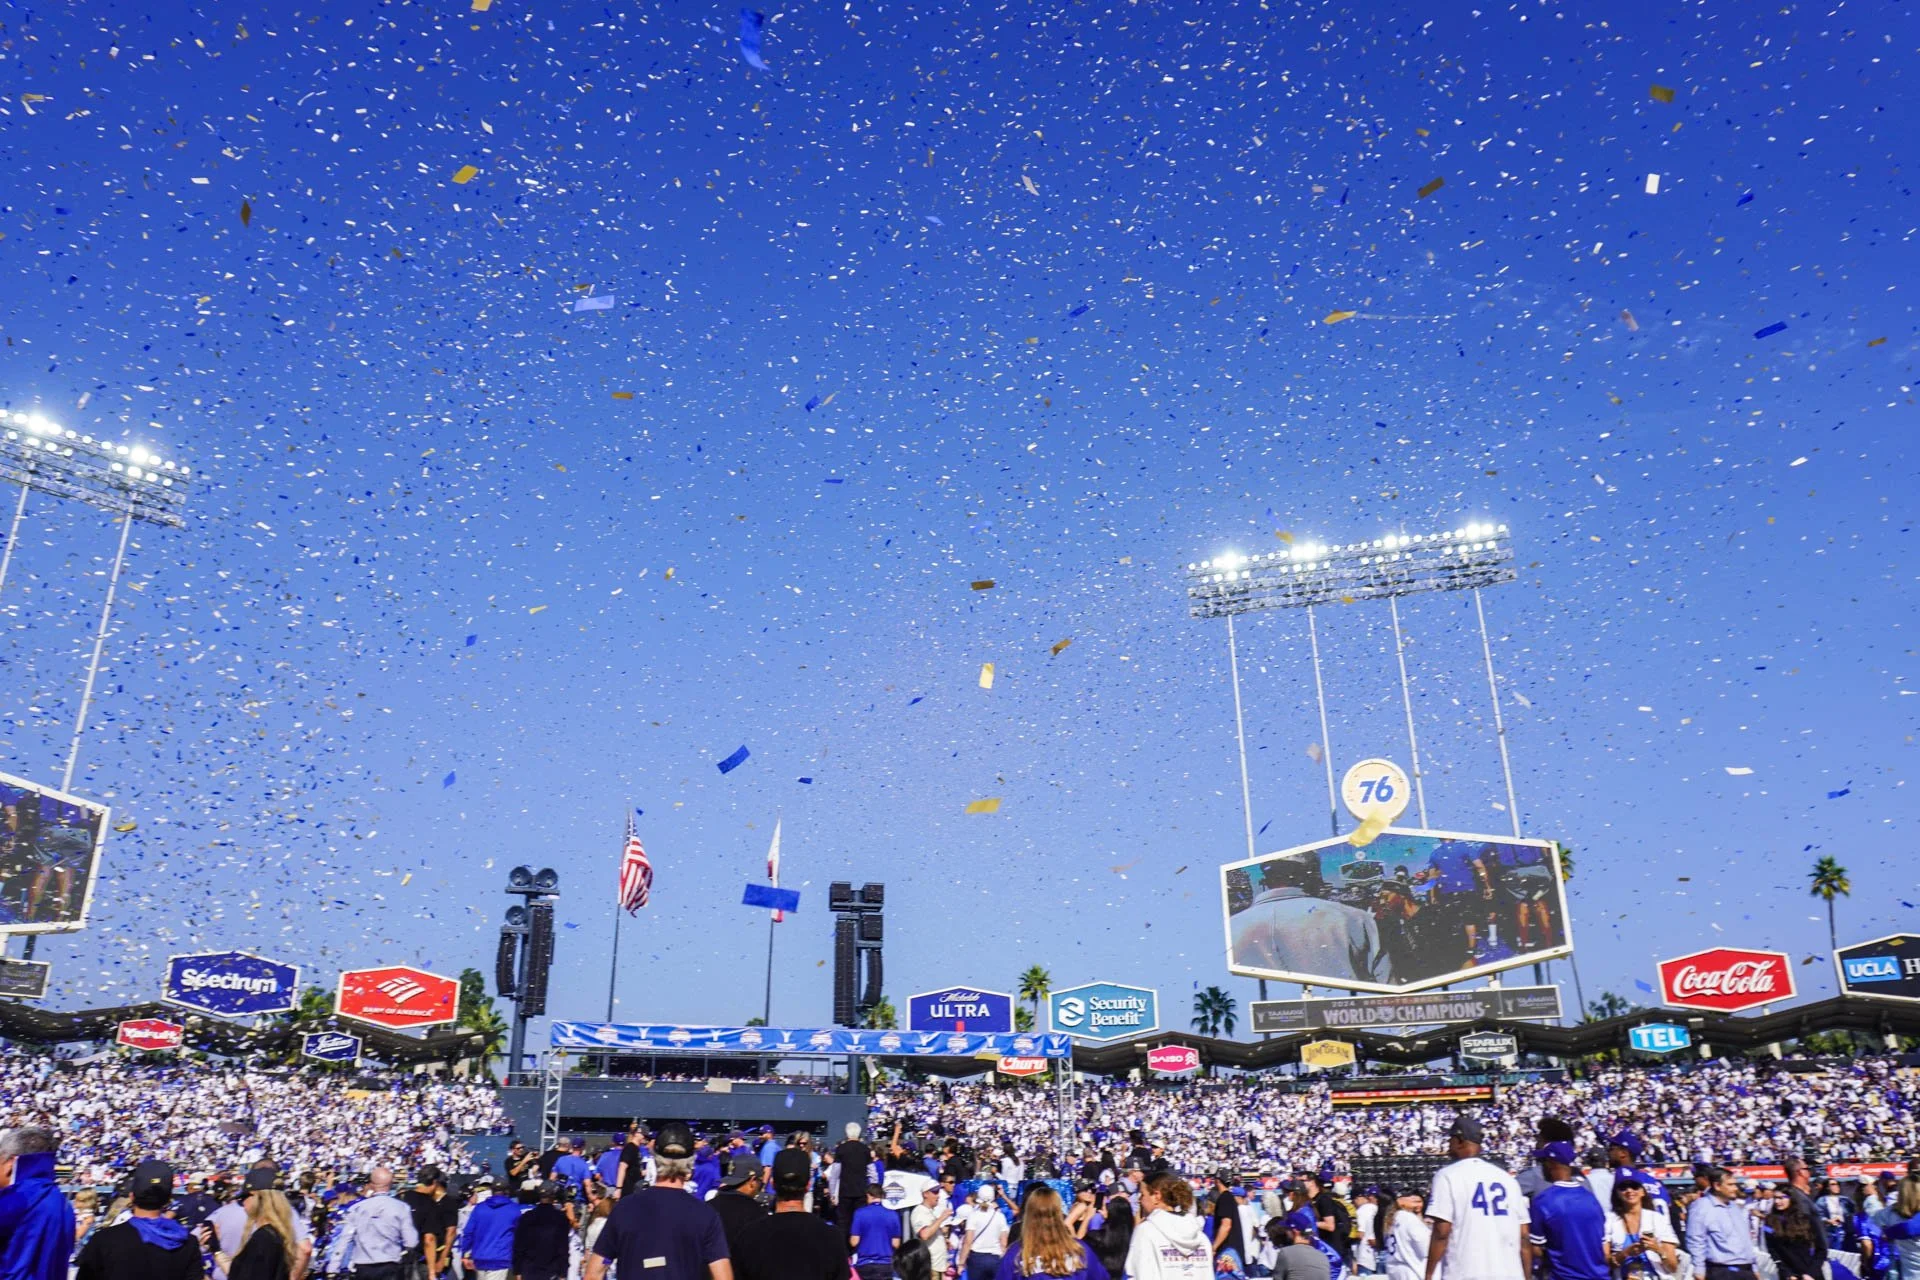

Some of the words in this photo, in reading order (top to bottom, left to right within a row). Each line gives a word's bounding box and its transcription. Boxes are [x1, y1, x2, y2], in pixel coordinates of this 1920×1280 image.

[1359, 775, 1393, 803] 76
[1848, 962, 1896, 977] UCLA
[180, 968, 278, 994] Spectrum
[930, 1003, 991, 1018] ULTRA
[1089, 996, 1147, 1011] Security
[1090, 1011, 1140, 1026] Benefit
[1322, 1006, 1377, 1025] WORLD
[1396, 1001, 1486, 1023] CHAMPIONS
[1463, 1038, 1513, 1048] STARLUX
[1635, 1028, 1684, 1048] TEL
[1151, 1055, 1184, 1064] DAISO
[1471, 1181, 1508, 1216] 42
